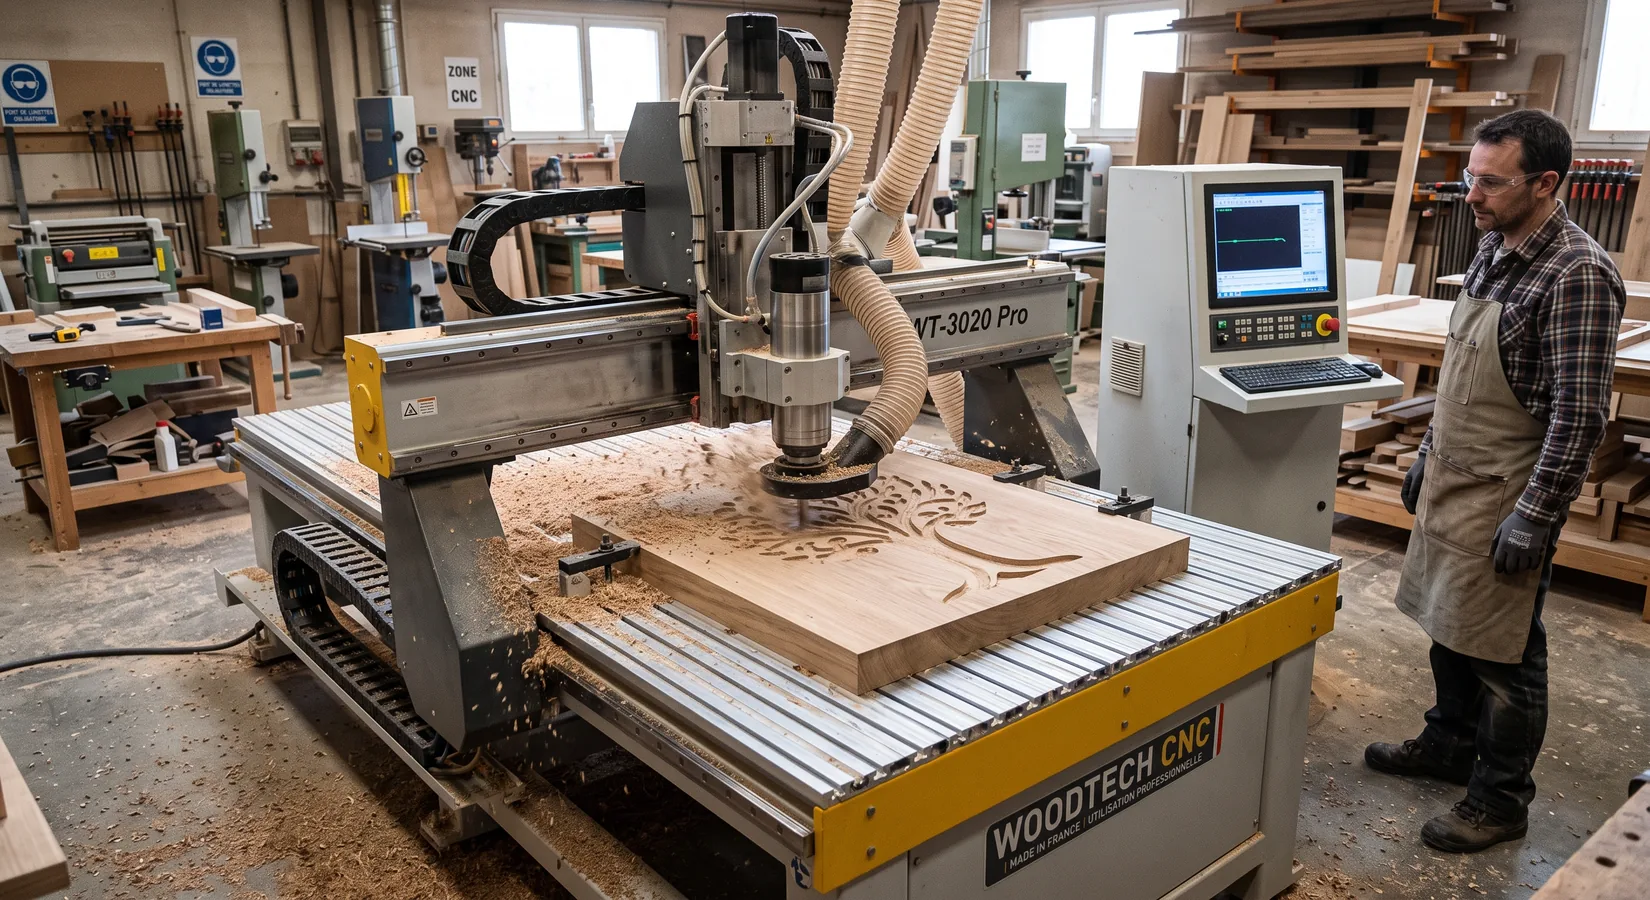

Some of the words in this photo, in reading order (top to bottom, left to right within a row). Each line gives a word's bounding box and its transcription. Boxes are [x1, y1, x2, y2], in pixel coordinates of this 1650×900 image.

[447, 65, 477, 78] ZONE
[451, 89, 477, 103] CNC
[997, 305, 1029, 328] Pro
[993, 745, 1154, 860] WOODTECH
[1160, 716, 1211, 767] CNC
[1009, 847, 1035, 870] MADE
[1036, 842, 1046, 855] IN
[1047, 824, 1081, 849] FRANCE
[1087, 790, 1136, 825] UTILISATION
[1136, 751, 1203, 798] PROFESSIONNELLE
